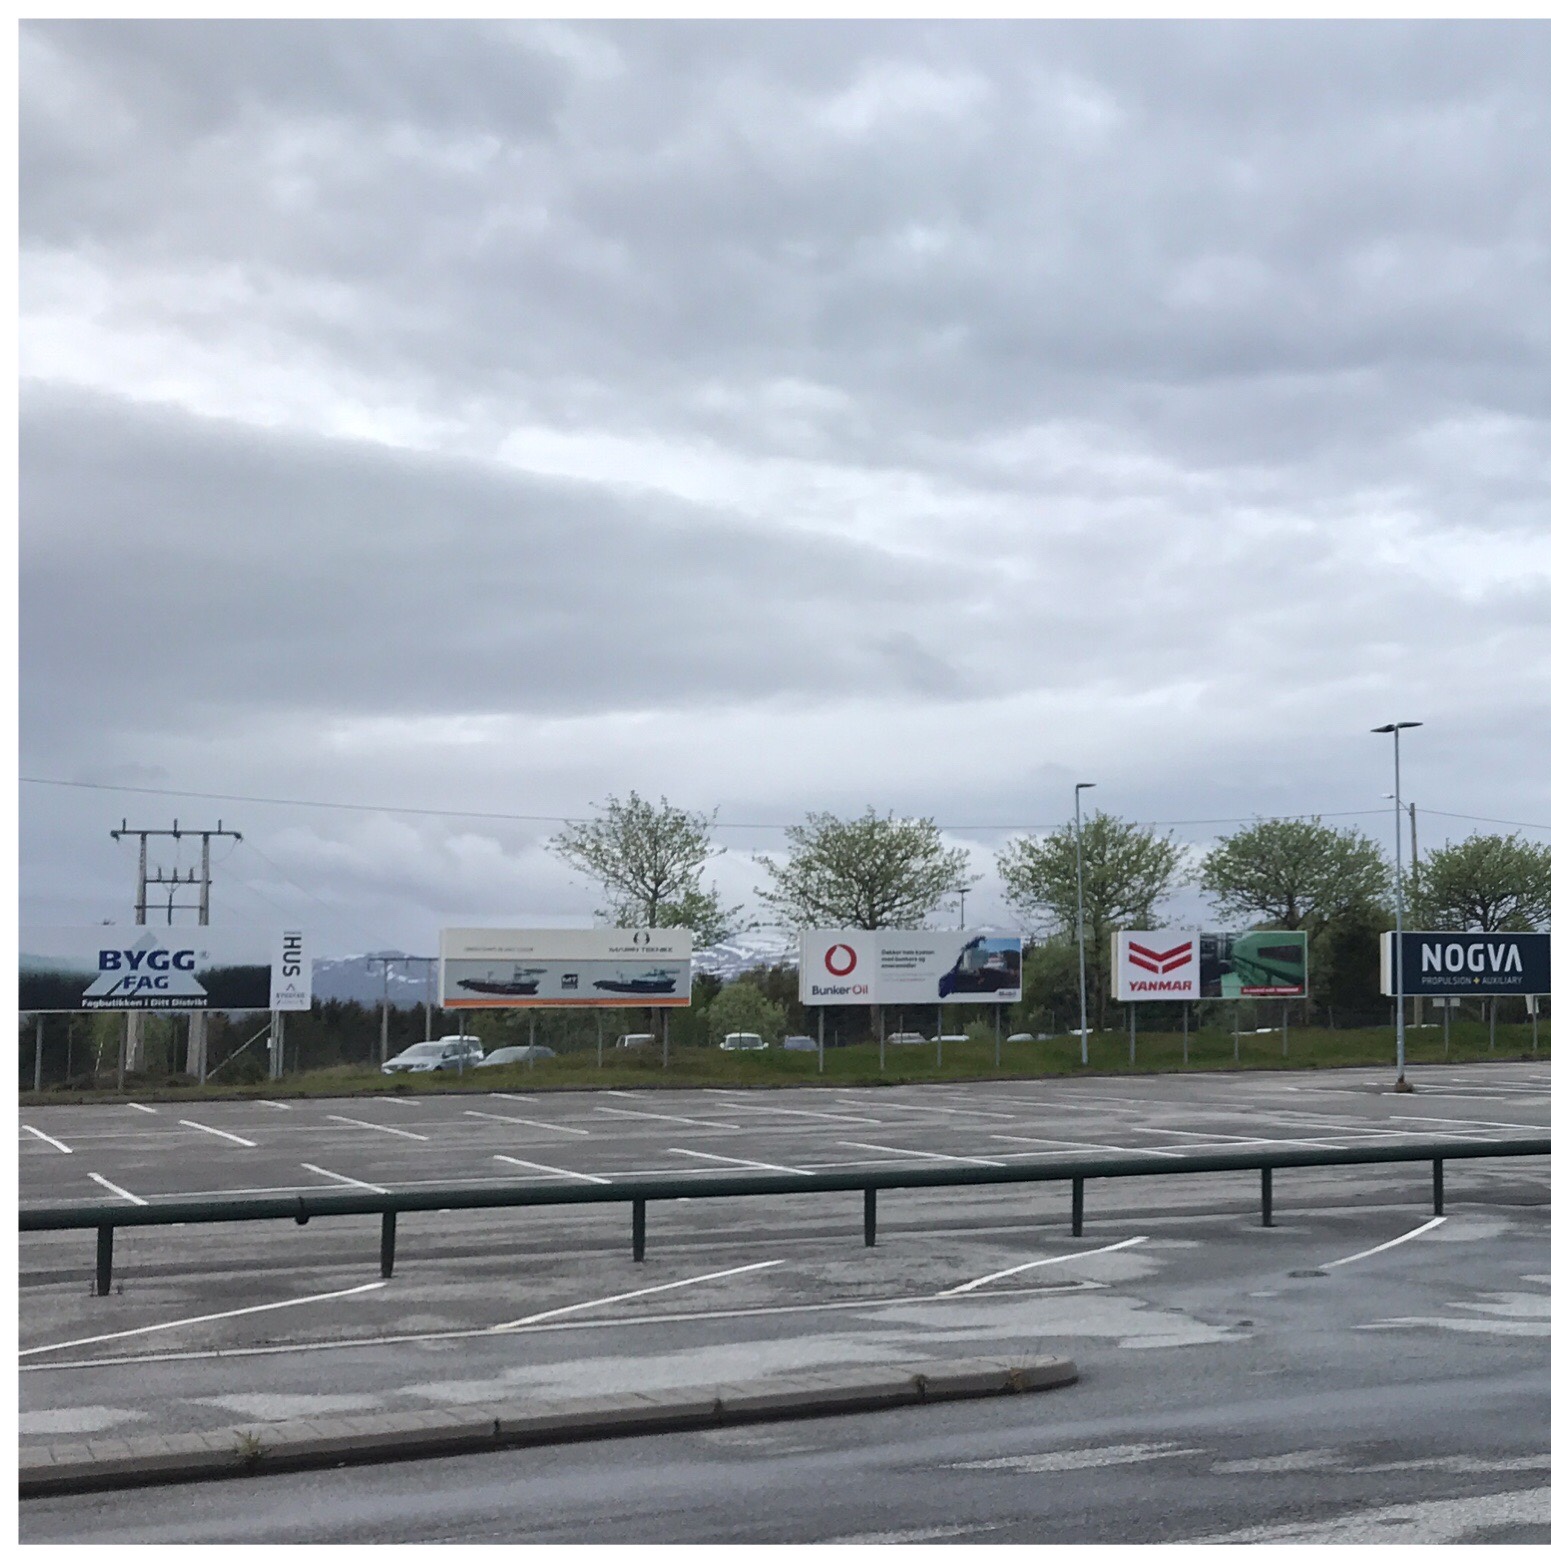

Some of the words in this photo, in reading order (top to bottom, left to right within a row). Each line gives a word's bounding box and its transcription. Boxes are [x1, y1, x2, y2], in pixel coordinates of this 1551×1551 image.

[99, 950, 195, 970] BYGG
[283, 937, 302, 977] HUS
[1421, 943, 1523, 972] NOGVA
[123, 975, 169, 989] FAG
[1129, 980, 1192, 991] YANMAR
[1421, 976, 1472, 985] PROPULSION
[1482, 976, 1523, 985] AUXILIARY
[82, 998, 143, 1008] Fagbutikken
